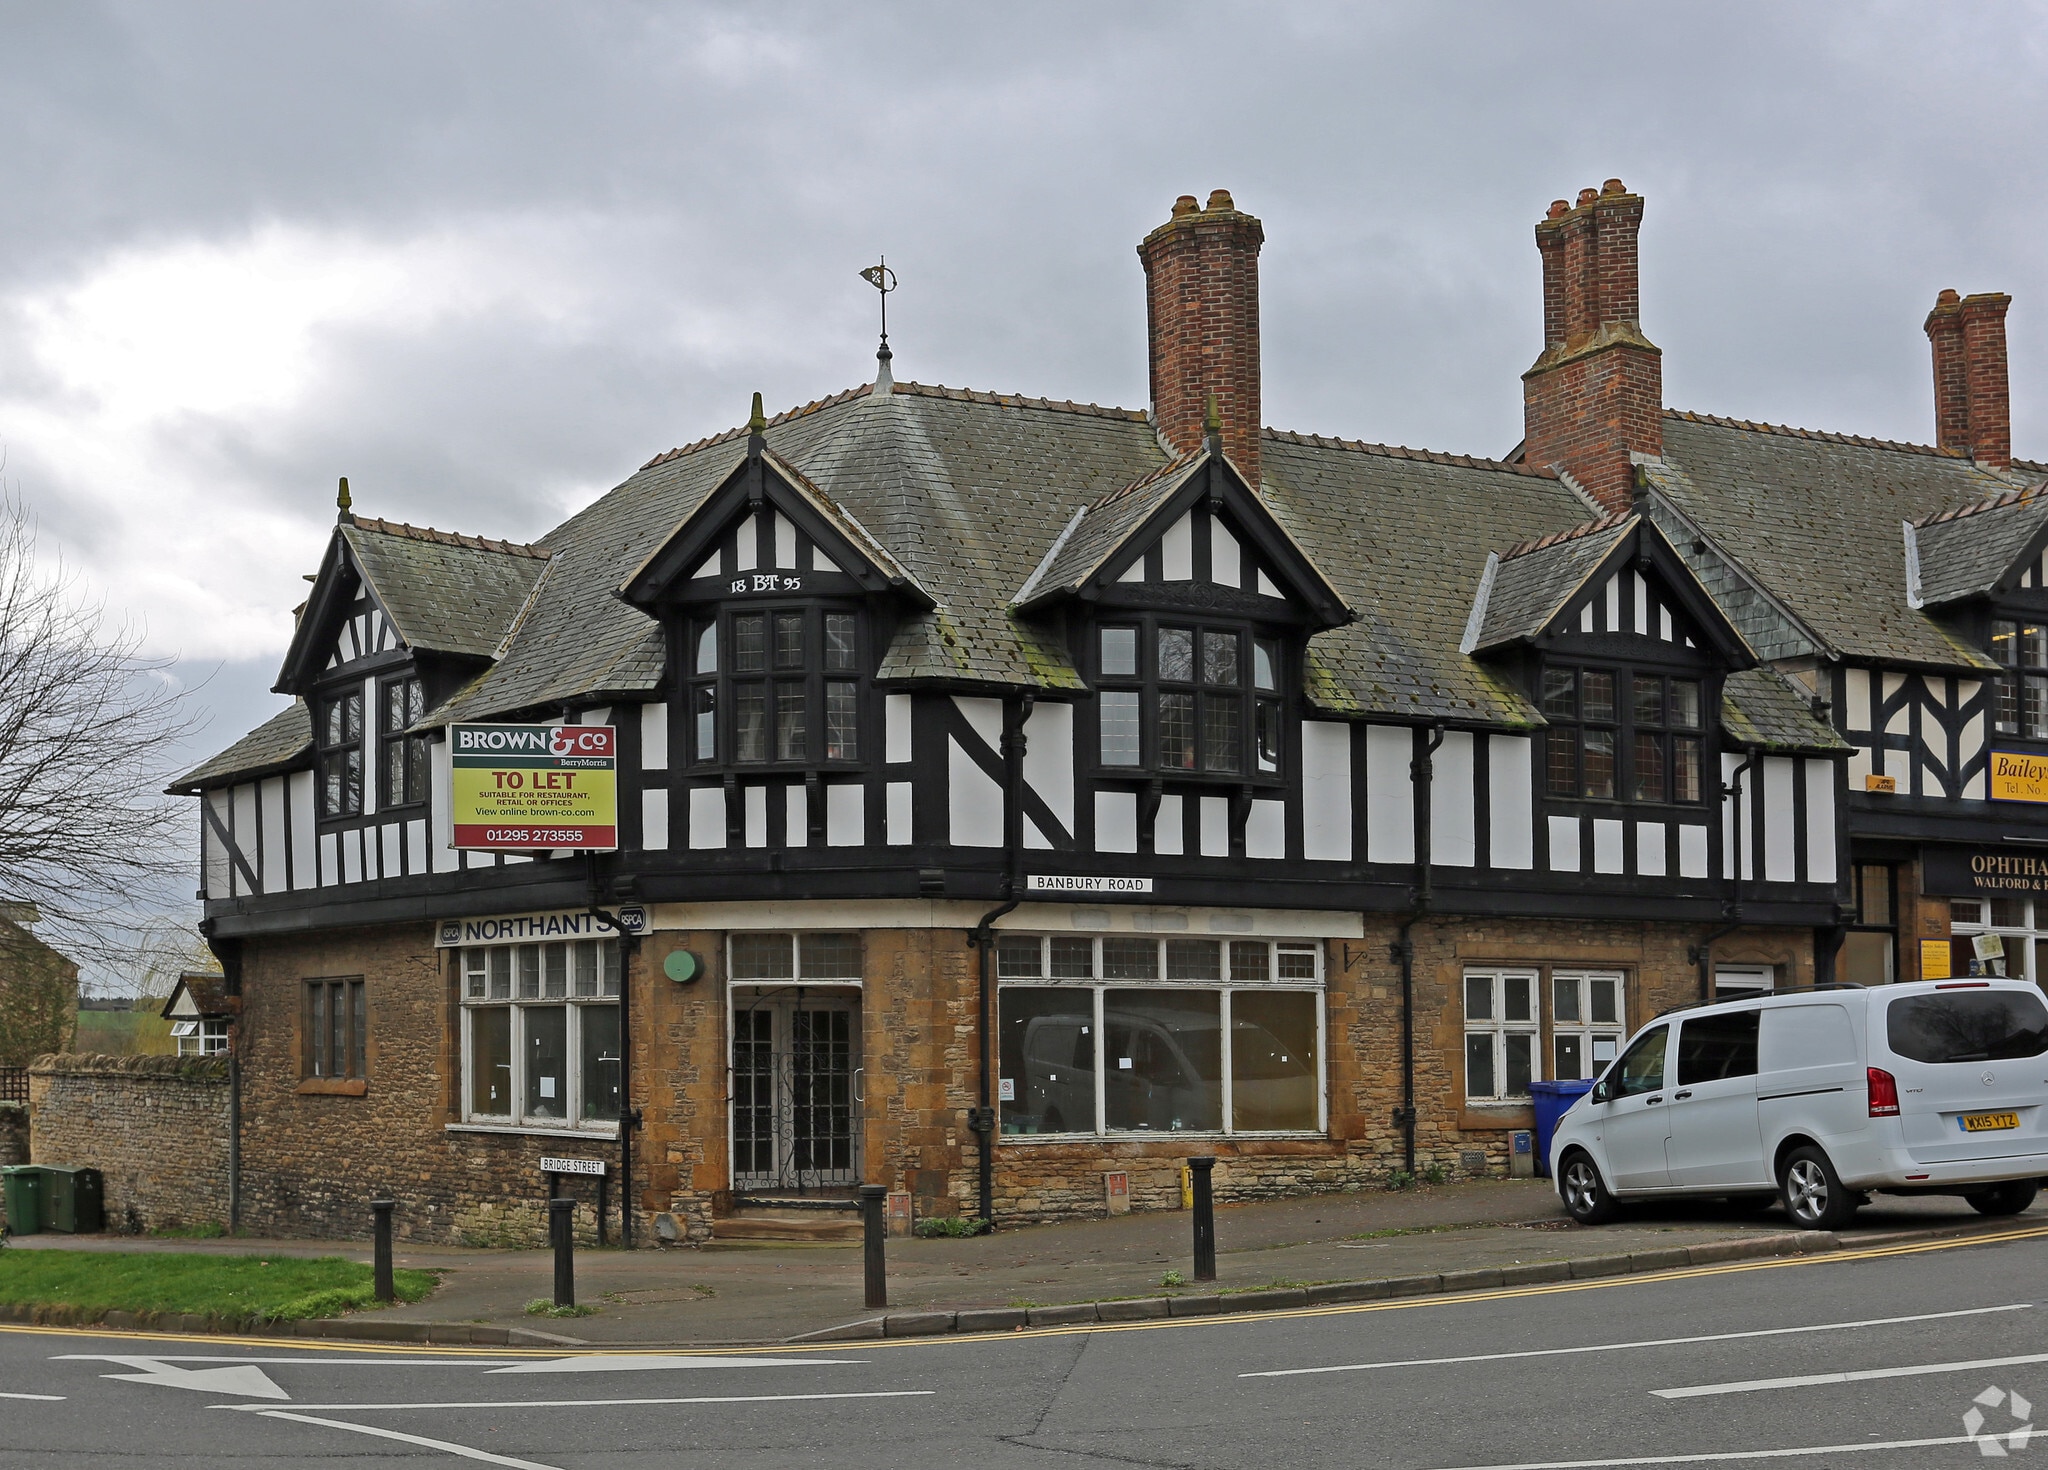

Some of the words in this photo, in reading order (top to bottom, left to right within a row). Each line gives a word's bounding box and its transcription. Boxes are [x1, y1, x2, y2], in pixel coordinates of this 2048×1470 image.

[731, 579, 747, 593] 18
[783, 577, 801, 590] 95
[459, 731, 546, 750] BROWN
[548, 727, 575, 756] &
[560, 758, 607, 767] BerryMorris
[492, 771, 524, 789] TO
[533, 772, 577, 790] LET
[479, 791, 517, 799] SUITABLE
[519, 791, 535, 799] FOR
[537, 791, 591, 800] RESTAURANT,
[475, 807, 498, 817] View
[499, 807, 528, 816] online
[530, 808, 595, 817] brown-co.com
[486, 829, 530, 842] 01295
[532, 829, 583, 842] 273555
[1037, 877, 1102, 889] BANBURY
[1108, 879, 1144, 890] ROAD
[1973, 876, 2030, 890] WALFORD
[2032, 879, 2041, 890] &
[621, 913, 643, 926] RSPCA
[1993, 1114, 2016, 1127] YTZ
[544, 1159, 571, 1171] BRIDGE
[574, 1161, 601, 1173] STREET
